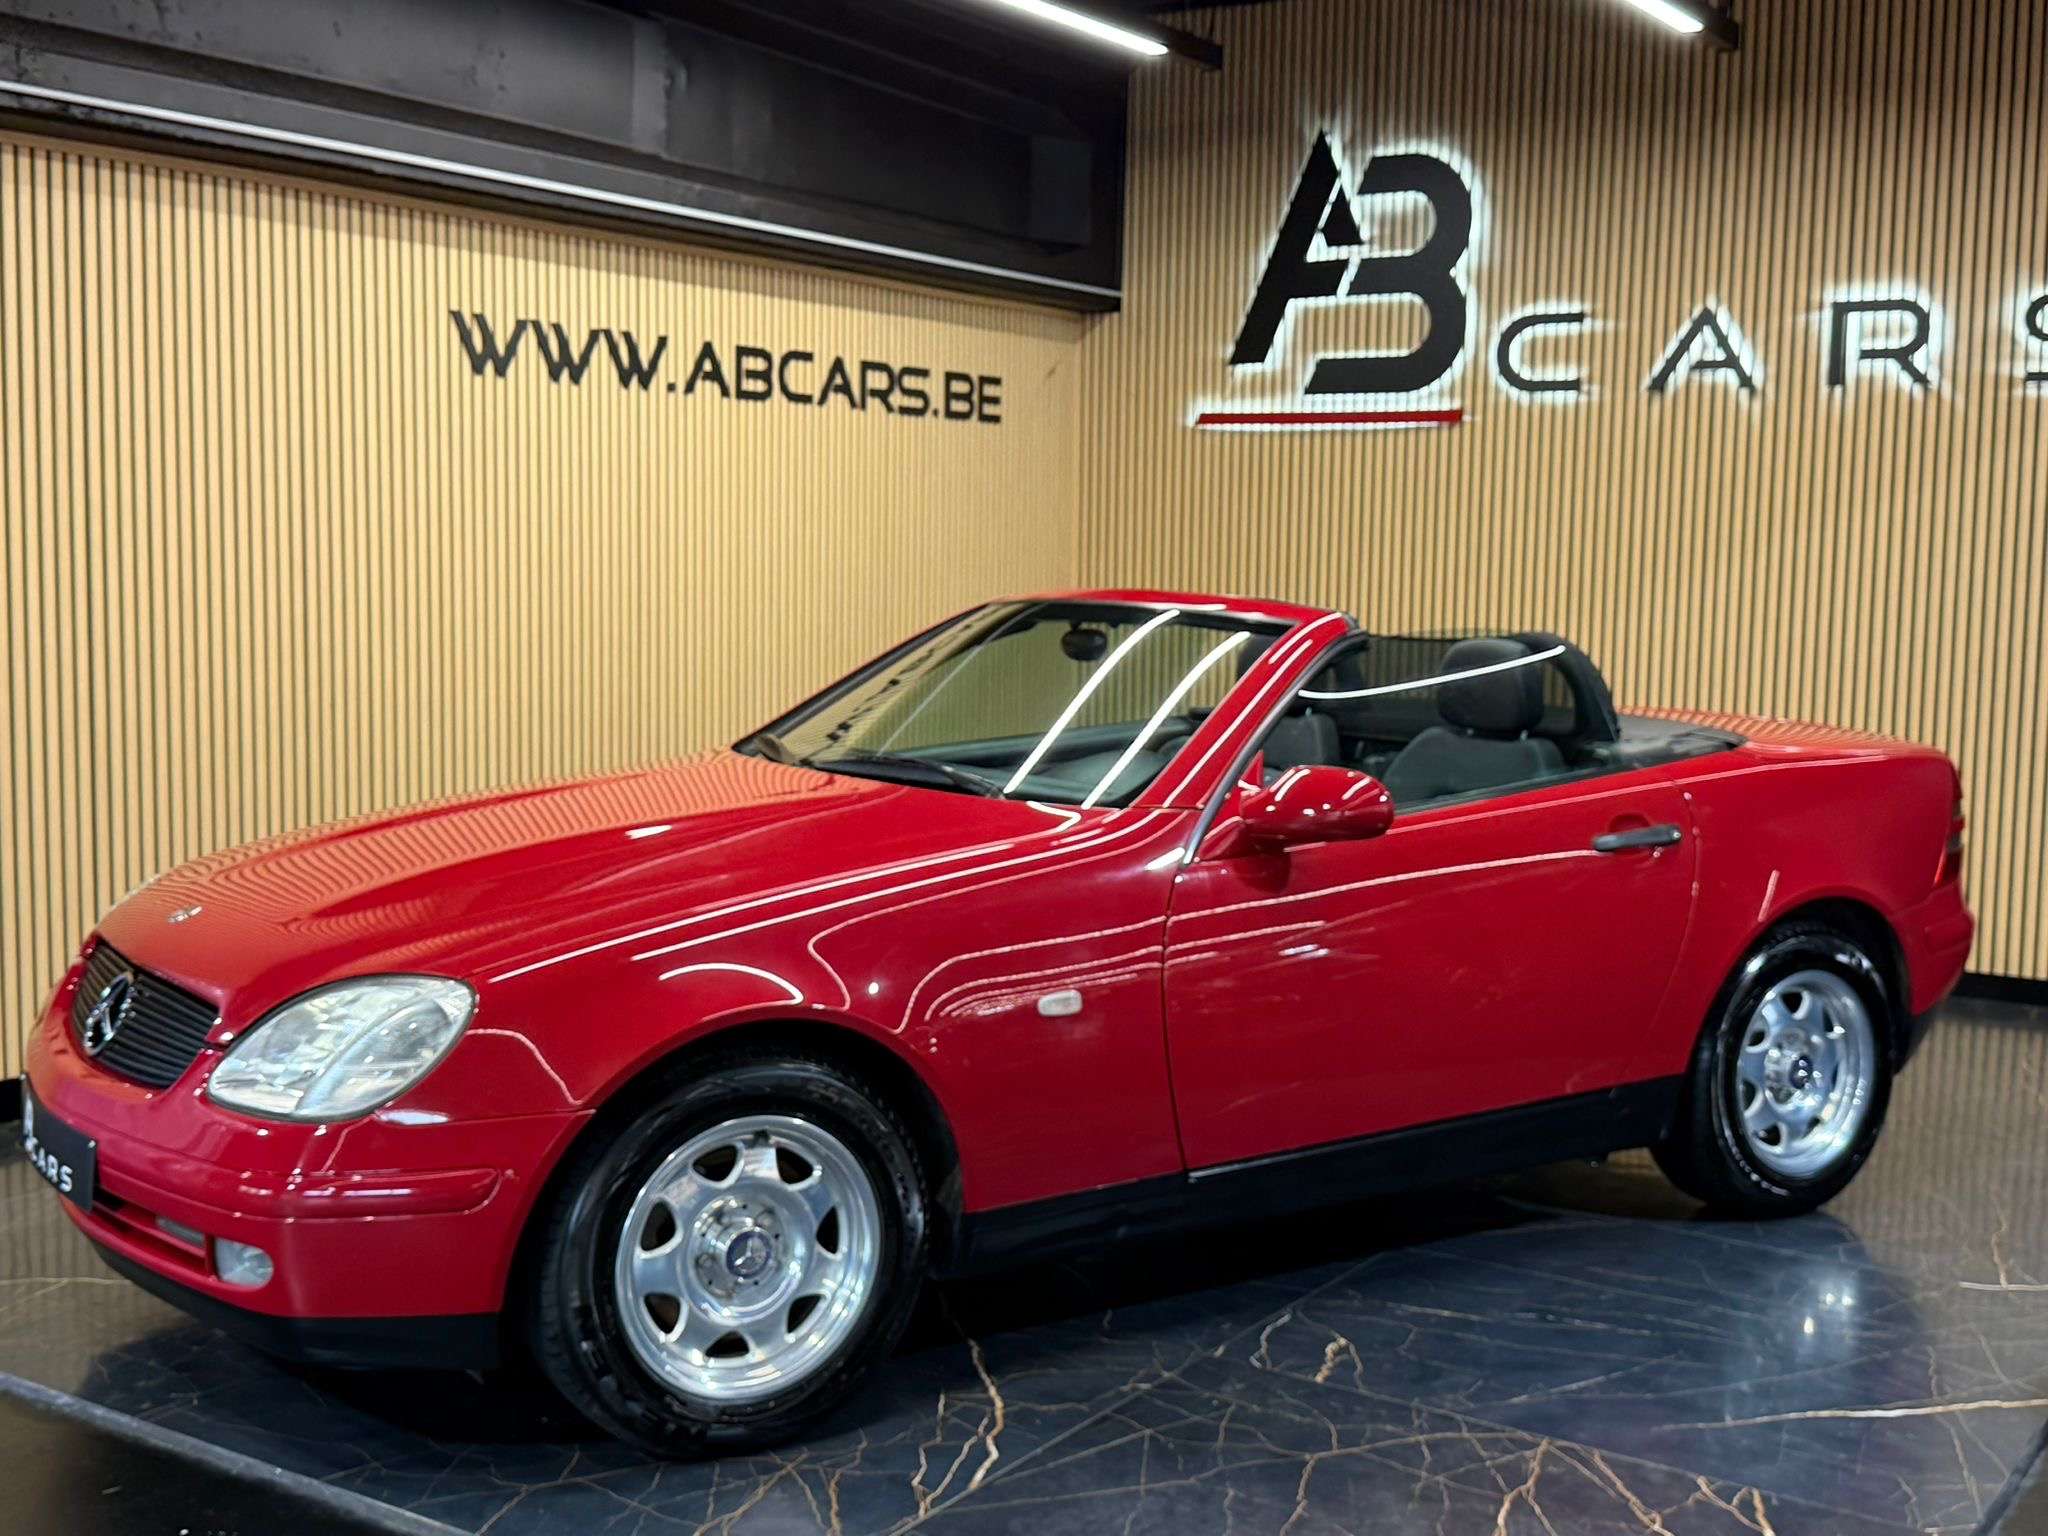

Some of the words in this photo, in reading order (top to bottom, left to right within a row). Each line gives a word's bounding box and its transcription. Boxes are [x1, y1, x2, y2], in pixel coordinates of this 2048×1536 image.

[1228, 128, 1474, 395] AB
[1497, 294, 2048, 394] CAR
[448, 310, 1002, 424] WWW.ABCARS.BE
